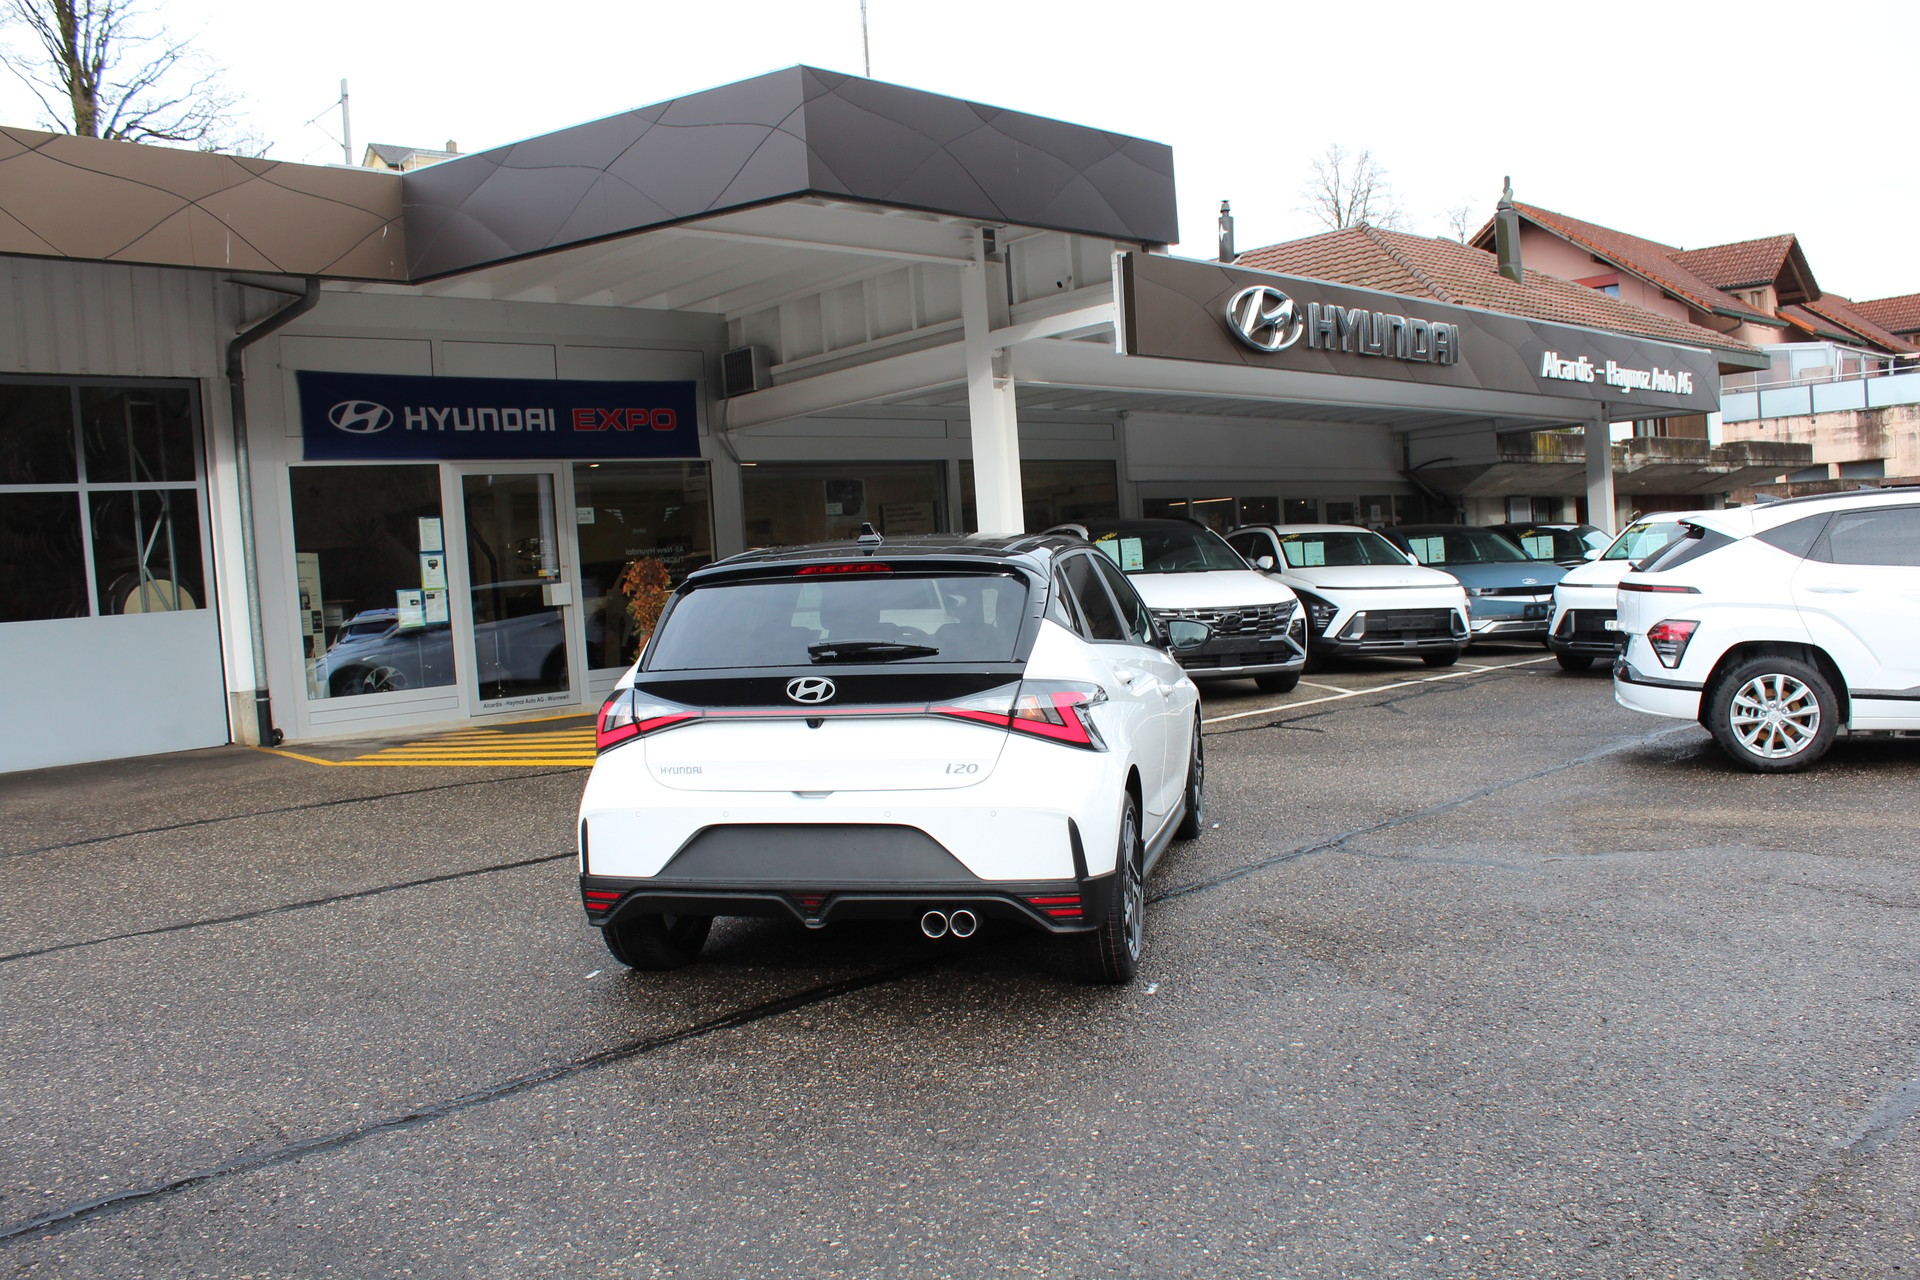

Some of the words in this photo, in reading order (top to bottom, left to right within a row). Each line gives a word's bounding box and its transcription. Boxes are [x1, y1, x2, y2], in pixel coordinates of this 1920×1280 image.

[1307, 302, 1459, 365] HYUNDAI
[1541, 351, 1594, 383] Alcardis
[1605, 360, 1651, 393] Haymoz
[1651, 367, 1676, 393] Auto
[1676, 371, 1693, 394] AG
[404, 406, 556, 432] HYUNDAI
[572, 407, 677, 432] EXPO
[506, 699, 524, 707] Haymoz
[660, 766, 702, 775] HYUNDAI
[945, 763, 979, 774] i20
